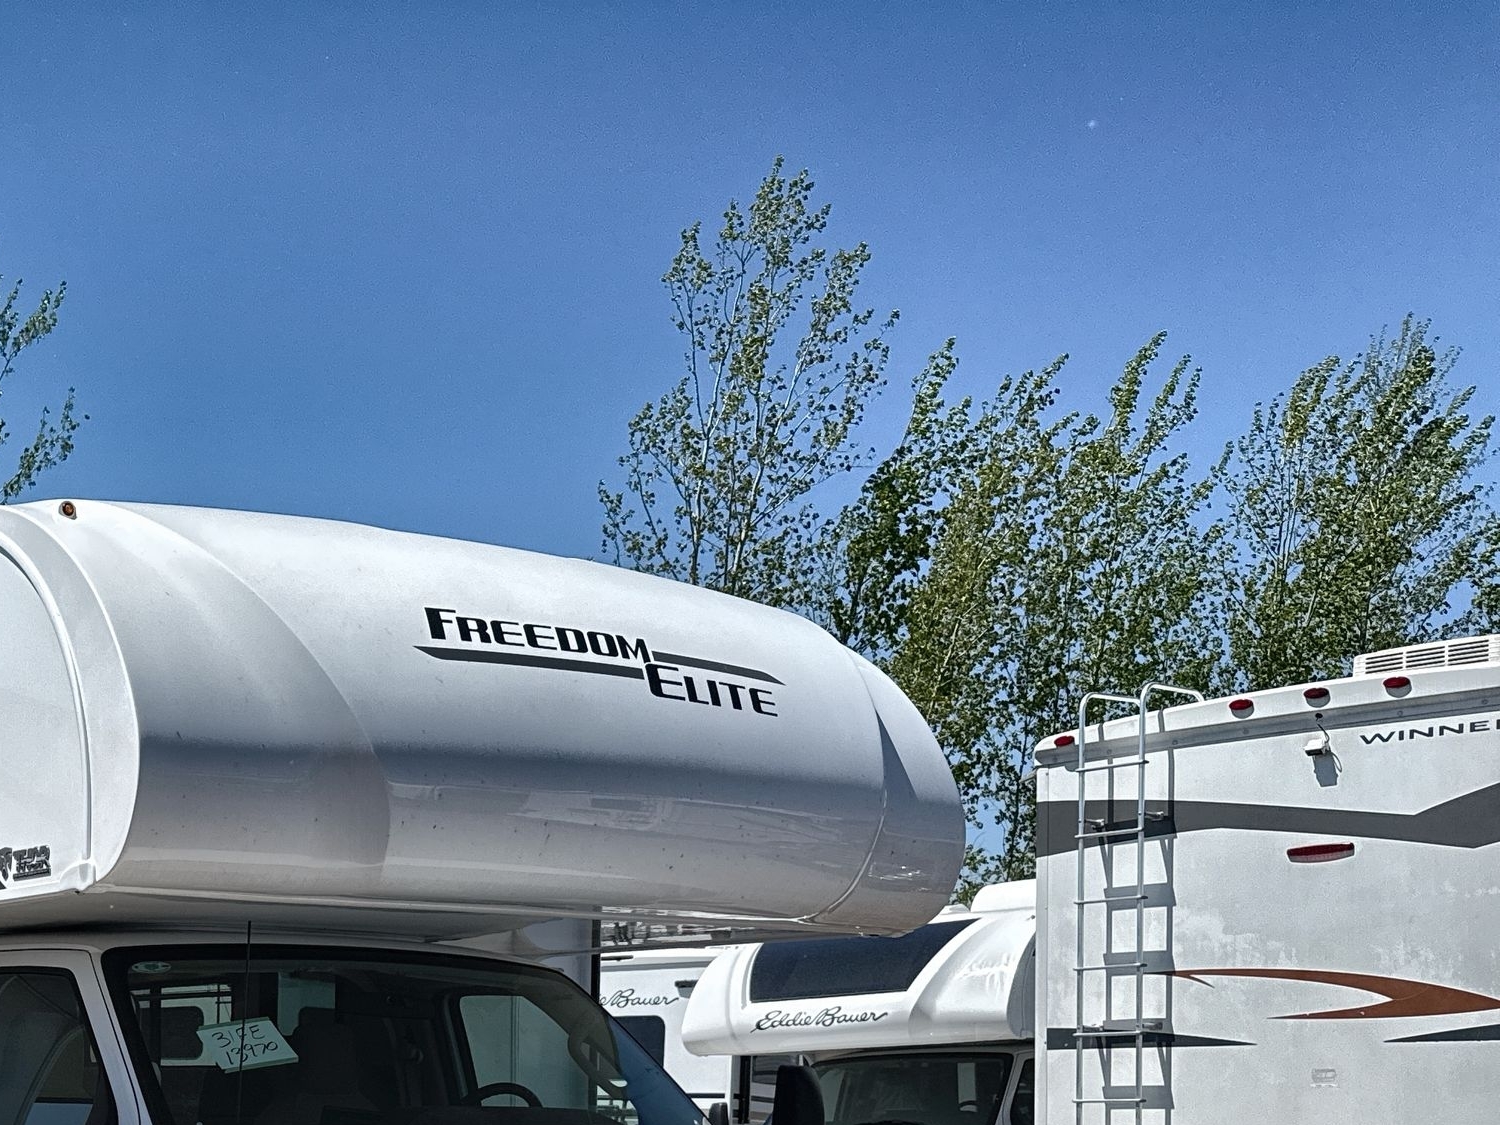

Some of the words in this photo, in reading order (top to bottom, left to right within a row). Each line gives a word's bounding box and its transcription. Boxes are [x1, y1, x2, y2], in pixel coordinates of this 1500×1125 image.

[424, 607, 651, 663] FREEDOM
[645, 662, 778, 717] ELITE
[1359, 718, 1500, 745] WINNE
[605, 988, 679, 1008] Bauer
[750, 1010, 814, 1033] Eddie
[813, 1005, 888, 1027] Bauer
